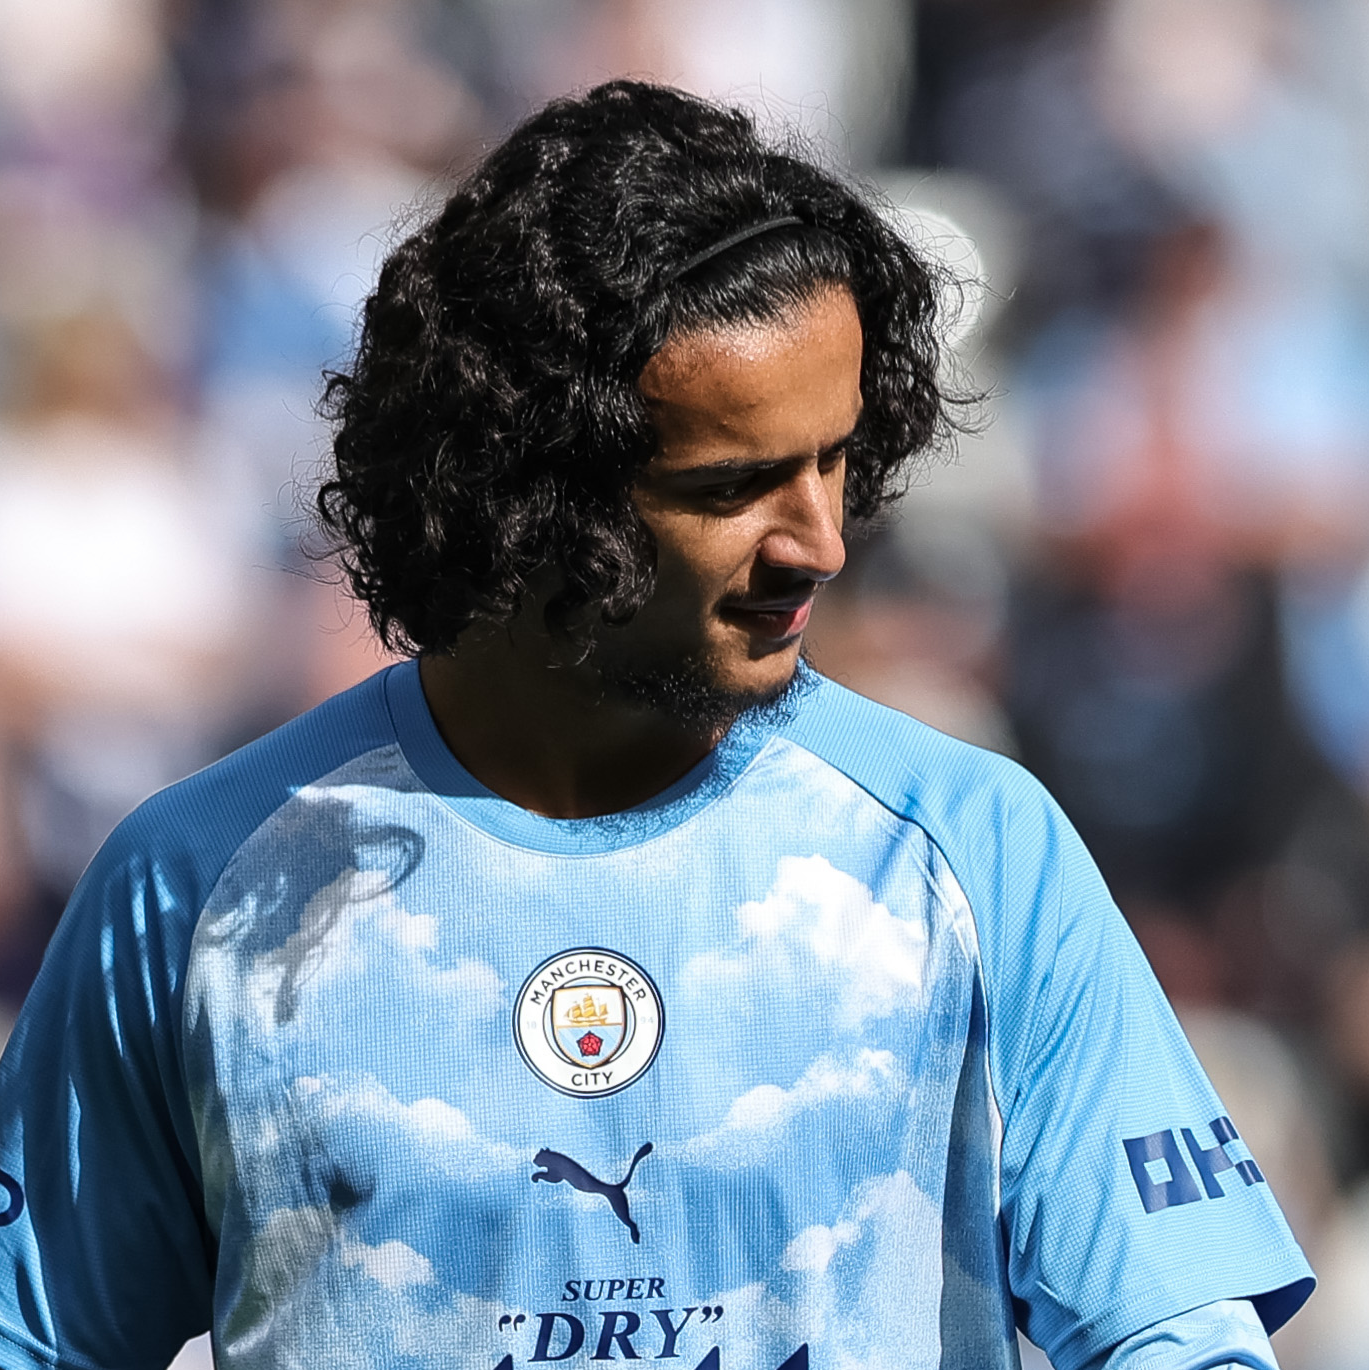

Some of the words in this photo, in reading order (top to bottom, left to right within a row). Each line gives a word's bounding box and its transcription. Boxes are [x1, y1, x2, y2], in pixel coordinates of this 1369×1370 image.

[530, 959, 647, 1005] MANCHESTER
[571, 1071, 613, 1086] CITY
[562, 1277, 665, 1301] SUPER
